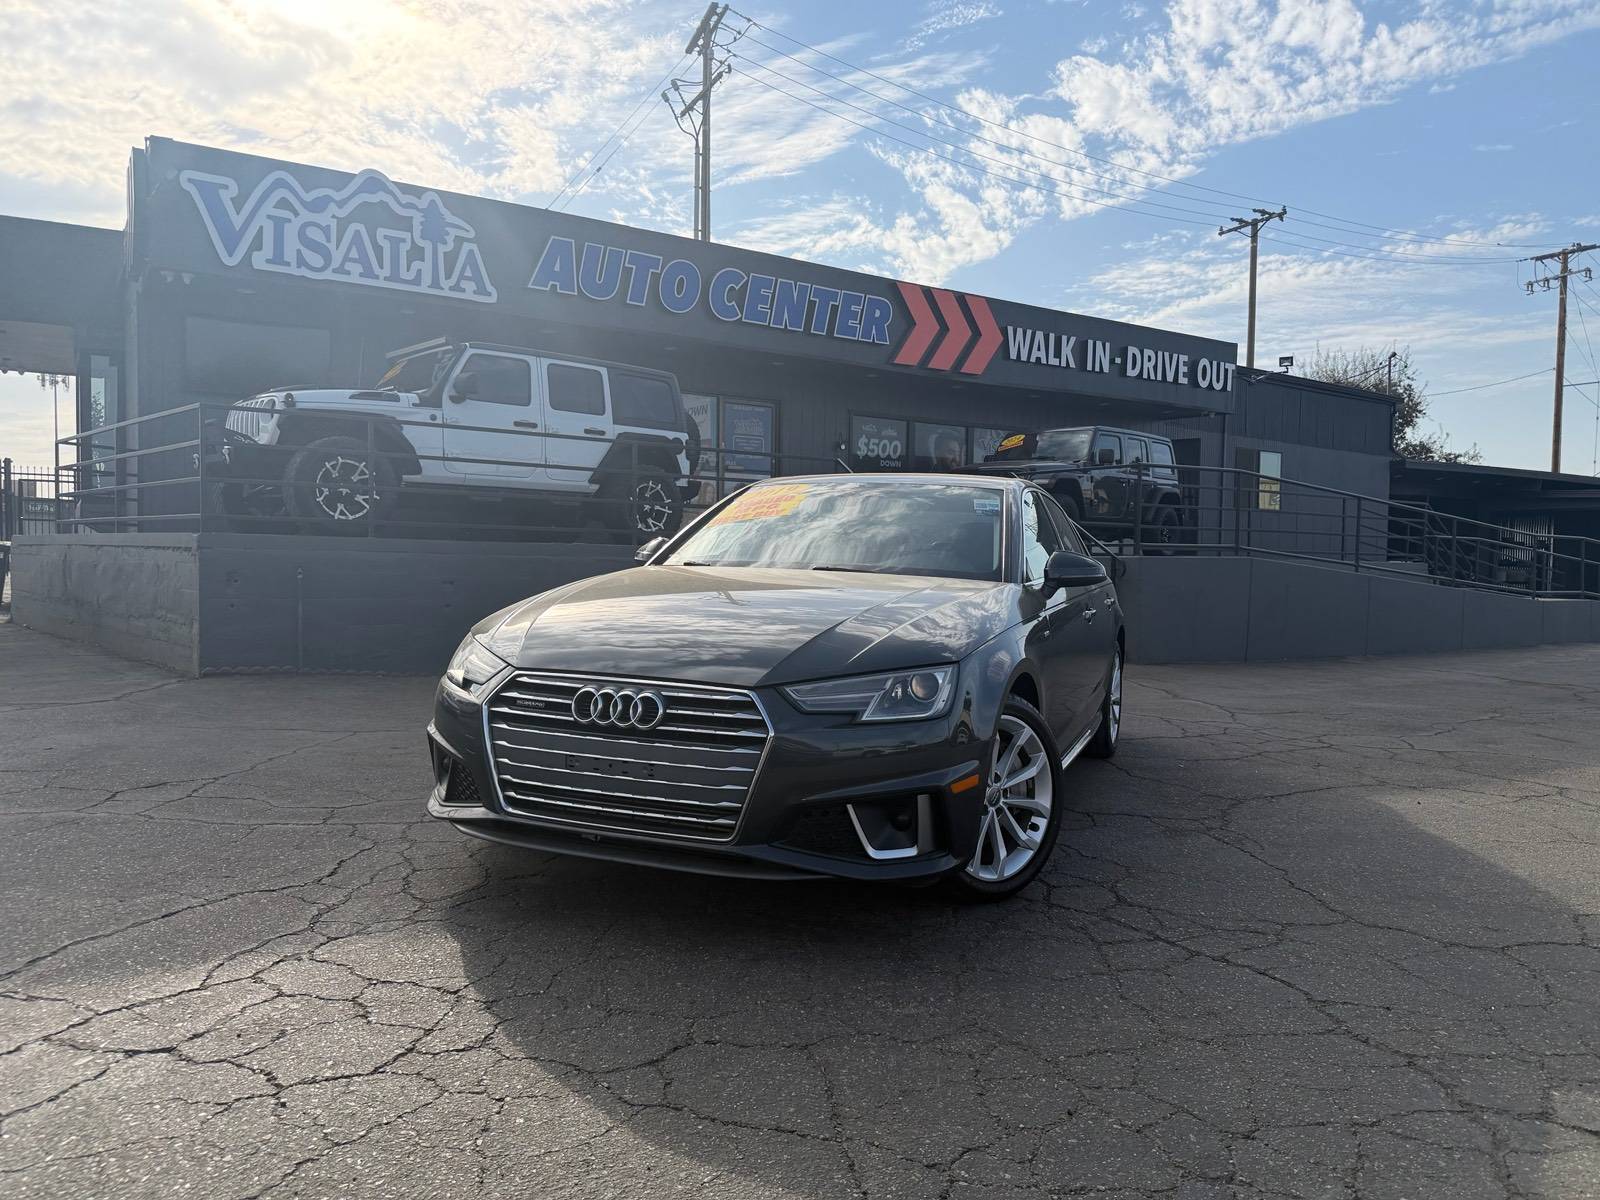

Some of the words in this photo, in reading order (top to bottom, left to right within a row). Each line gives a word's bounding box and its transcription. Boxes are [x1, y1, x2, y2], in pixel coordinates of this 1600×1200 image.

[180, 169, 497, 303] VISALIA
[528, 236, 701, 314] AUTO
[709, 268, 893, 345] CENTER
[1007, 325, 1077, 368] WALK
[1197, 357, 1236, 392] OUT
[856, 434, 902, 460] $500
[880, 459, 902, 468] DOWN
